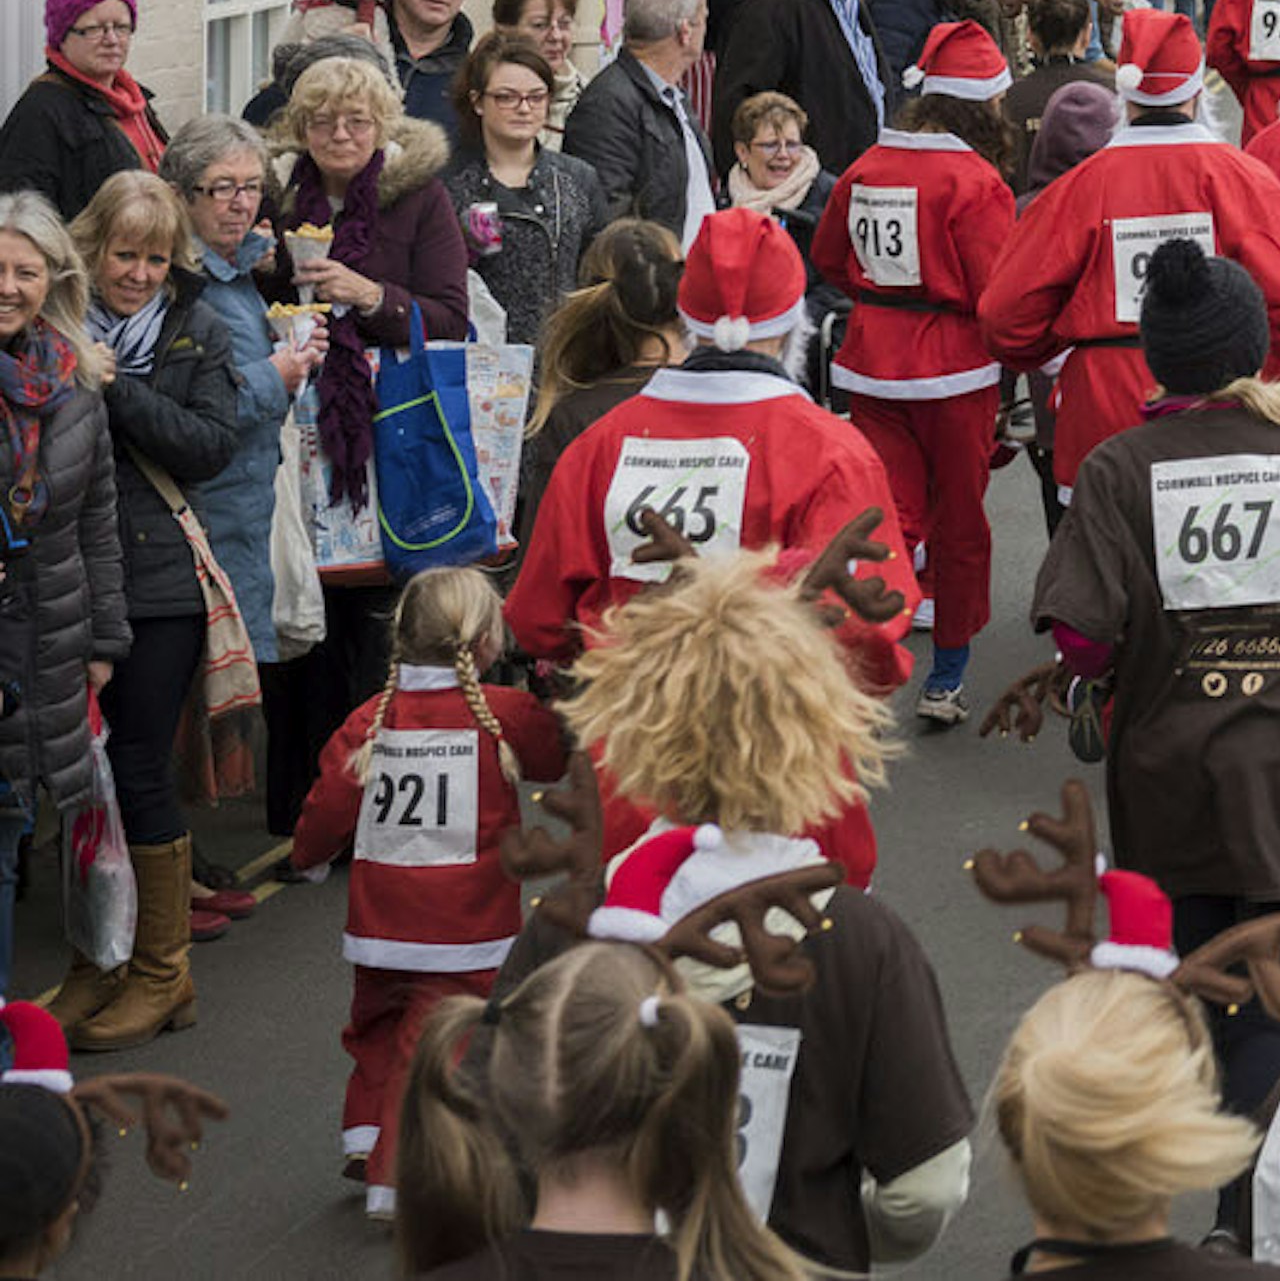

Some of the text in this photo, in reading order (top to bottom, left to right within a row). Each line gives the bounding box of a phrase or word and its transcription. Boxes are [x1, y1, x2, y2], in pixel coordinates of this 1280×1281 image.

[856, 217, 903, 258] 913
[624, 456, 677, 469] CORNWALL
[717, 456, 745, 468] CARE
[1157, 475, 1213, 491] CORNWALL
[1216, 471, 1260, 486] HOSPICE
[625, 484, 720, 543] 665
[1178, 500, 1275, 564] 667
[406, 746, 448, 758] HOSPICE
[449, 745, 474, 756] CARE
[373, 772, 449, 826] 921
[753, 1052, 790, 1071] CARE
